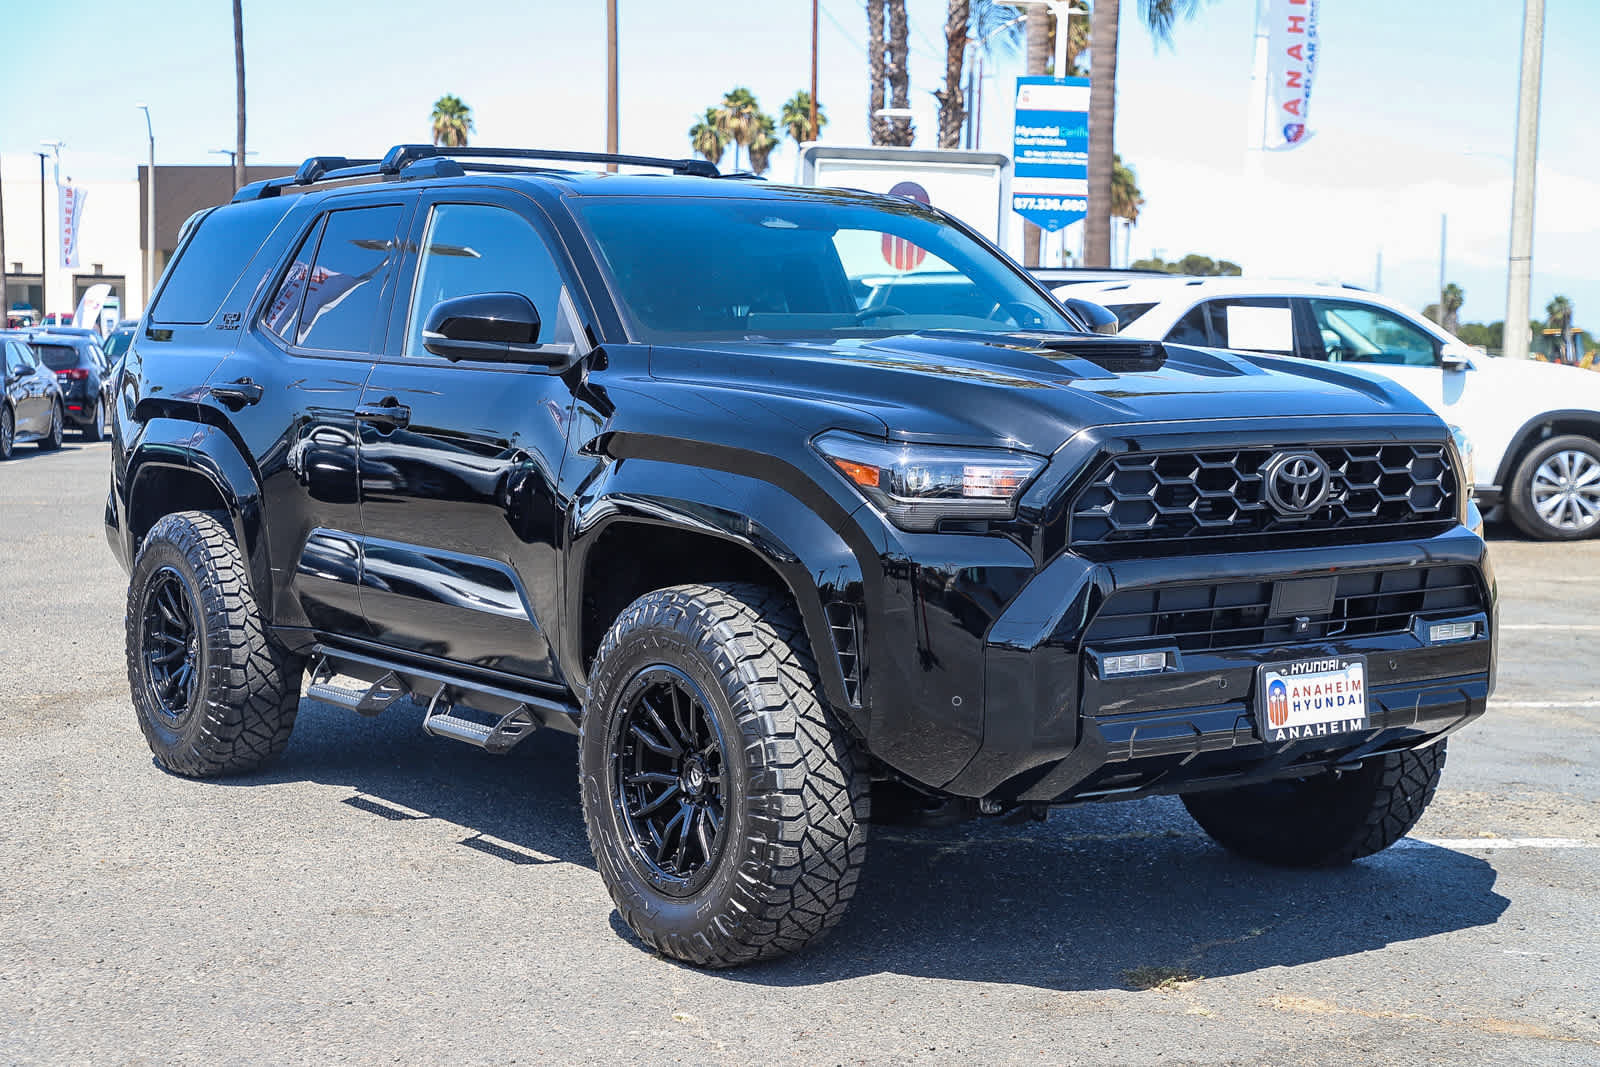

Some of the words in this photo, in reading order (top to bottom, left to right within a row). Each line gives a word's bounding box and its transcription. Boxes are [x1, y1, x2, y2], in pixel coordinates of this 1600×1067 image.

[1282, 0, 1307, 116] ANAH
[1291, 659, 1339, 674] HYUNDAI
[1292, 680, 1361, 698] ANAHEIM
[1293, 693, 1362, 712] HYUNDAI
[1275, 720, 1362, 741] ANAHEIM
